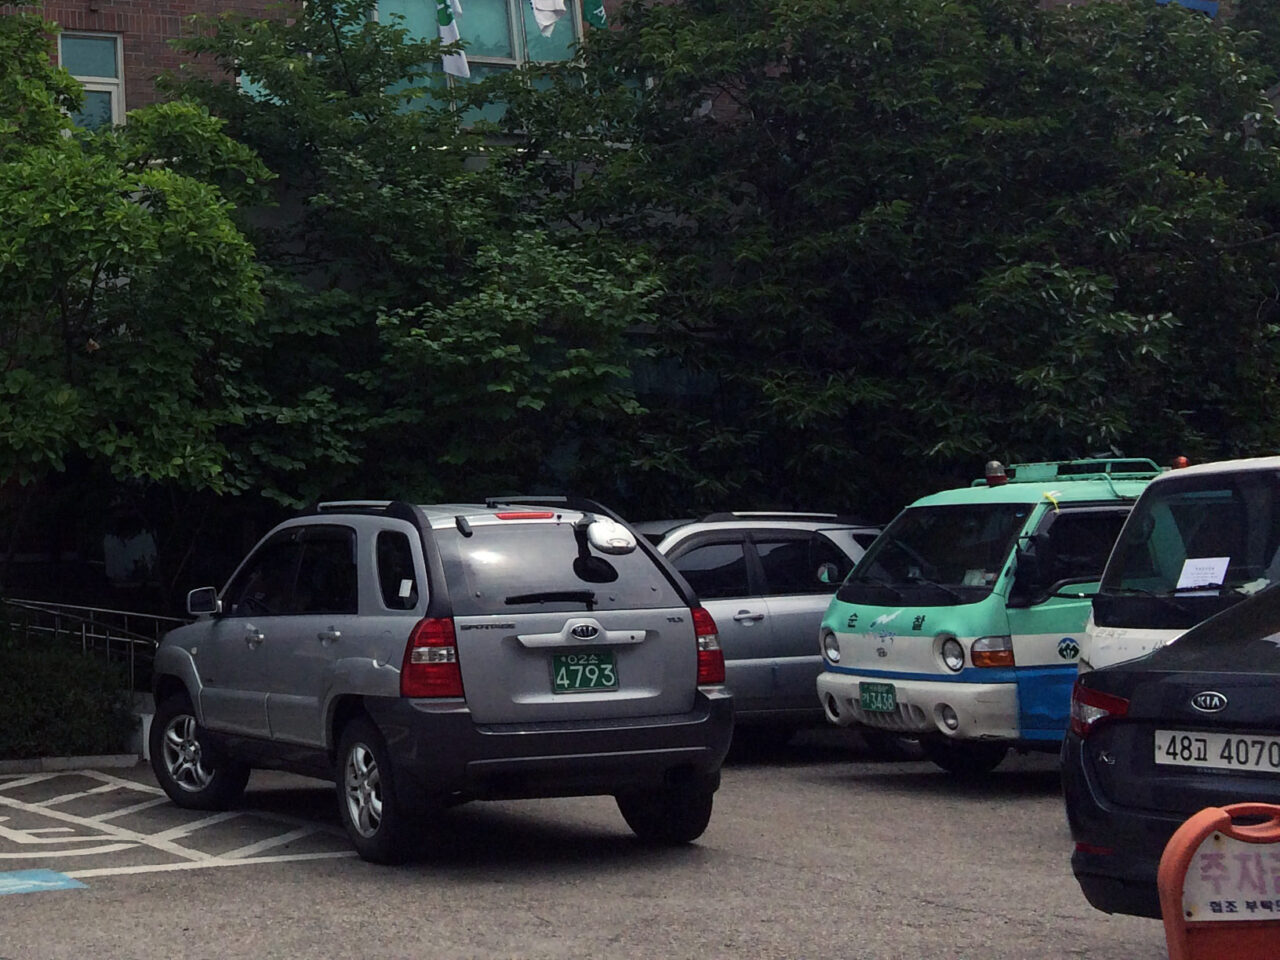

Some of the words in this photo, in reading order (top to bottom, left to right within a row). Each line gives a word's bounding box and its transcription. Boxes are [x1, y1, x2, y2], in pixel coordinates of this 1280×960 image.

[556, 664, 615, 689] 4793
[870, 692, 894, 710] 3438
[1196, 695, 1221, 709] KIA
[1165, 735, 1209, 763] 48고
[1219, 739, 1280, 770] 4070
